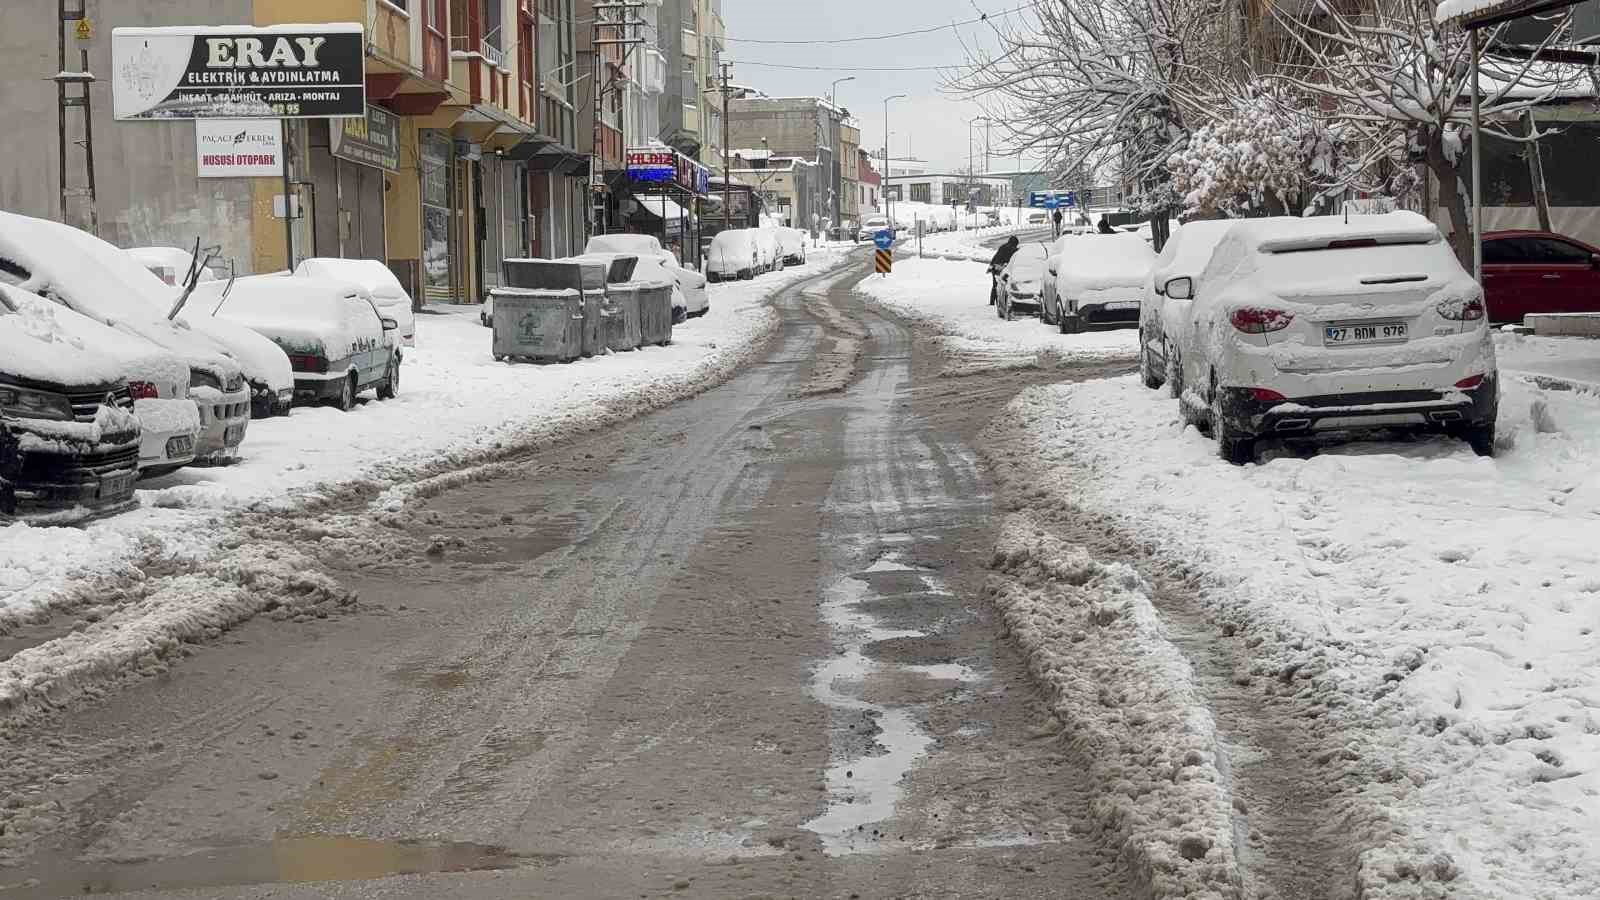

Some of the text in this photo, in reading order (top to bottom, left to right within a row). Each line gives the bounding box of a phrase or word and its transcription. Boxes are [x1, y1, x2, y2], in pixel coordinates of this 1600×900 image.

[205, 37, 326, 68] ERAY
[188, 69, 245, 83] ELEKTRİK
[262, 71, 340, 83] AYDINLATMA
[268, 92, 296, 101] ARIZA
[302, 92, 340, 101] MONTAJ
[287, 103, 300, 114] 95
[236, 154, 275, 166] OTOPARK
[1332, 329, 1346, 341] 27
